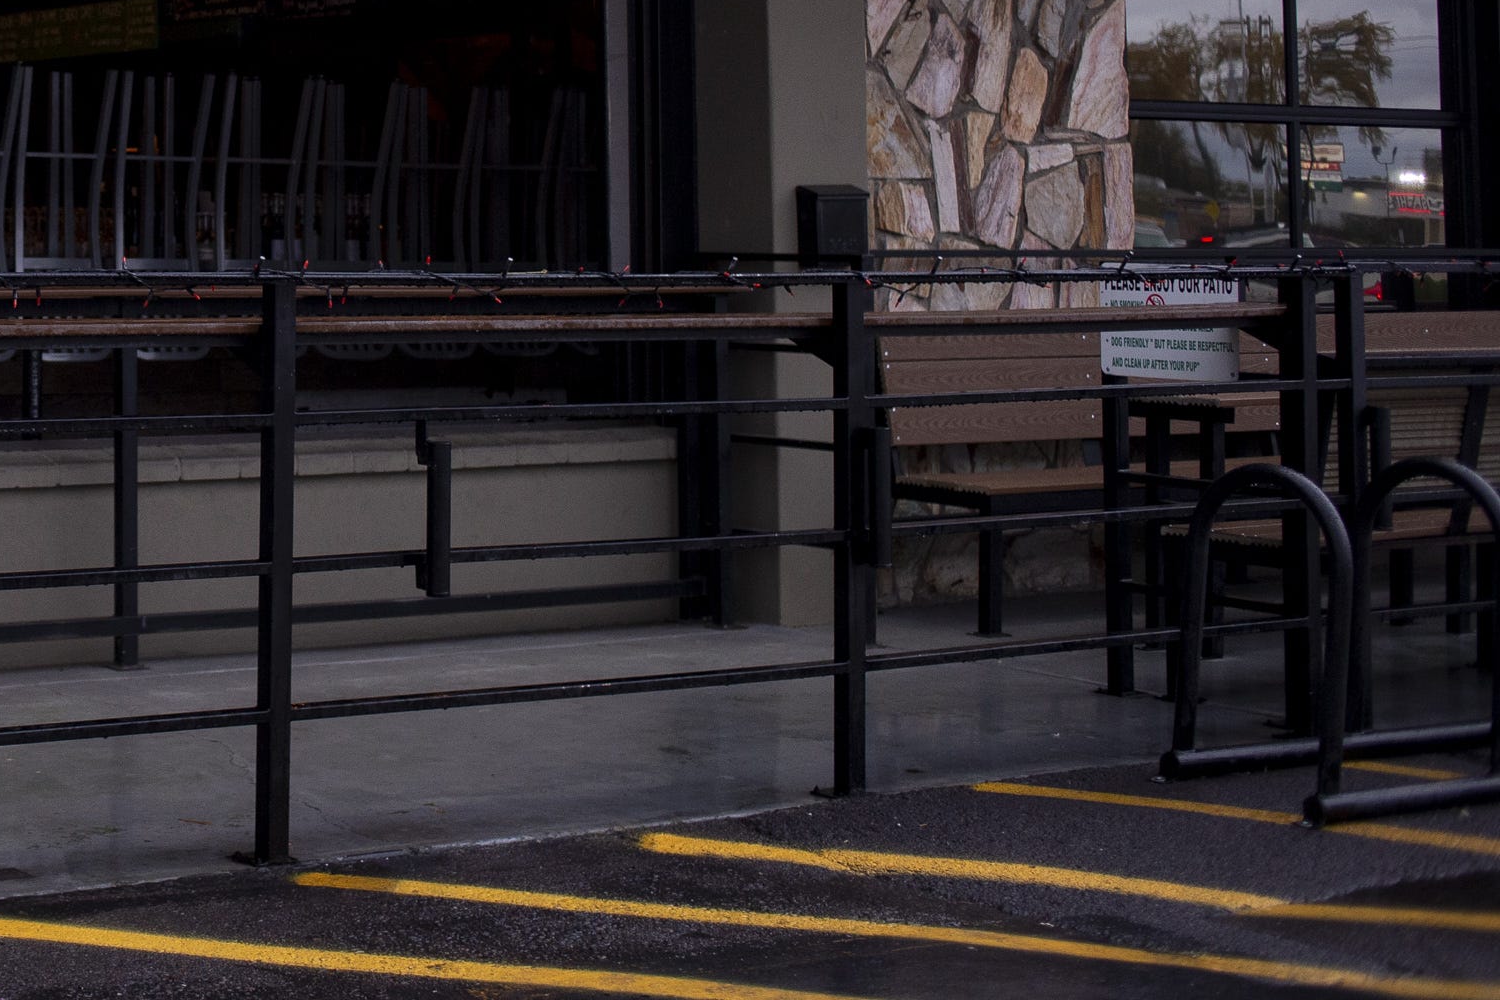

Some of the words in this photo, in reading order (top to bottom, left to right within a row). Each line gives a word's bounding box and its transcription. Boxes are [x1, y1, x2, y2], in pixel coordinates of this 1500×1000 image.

[1111, 336, 1122, 347] DOG
[1124, 337, 1148, 348] FRIENDLY
[1154, 339, 1166, 349] BUT
[1167, 340, 1188, 350] PLEASE
[1189, 341, 1197, 351] BE
[1198, 341, 1234, 353] RESPECTFUL
[1112, 357, 1123, 367] AND
[1125, 358, 1141, 369] CLEAN
[1143, 359, 1150, 369] UP
[1151, 360, 1168, 370] AFTER
[1170, 360, 1184, 371] YOUR
